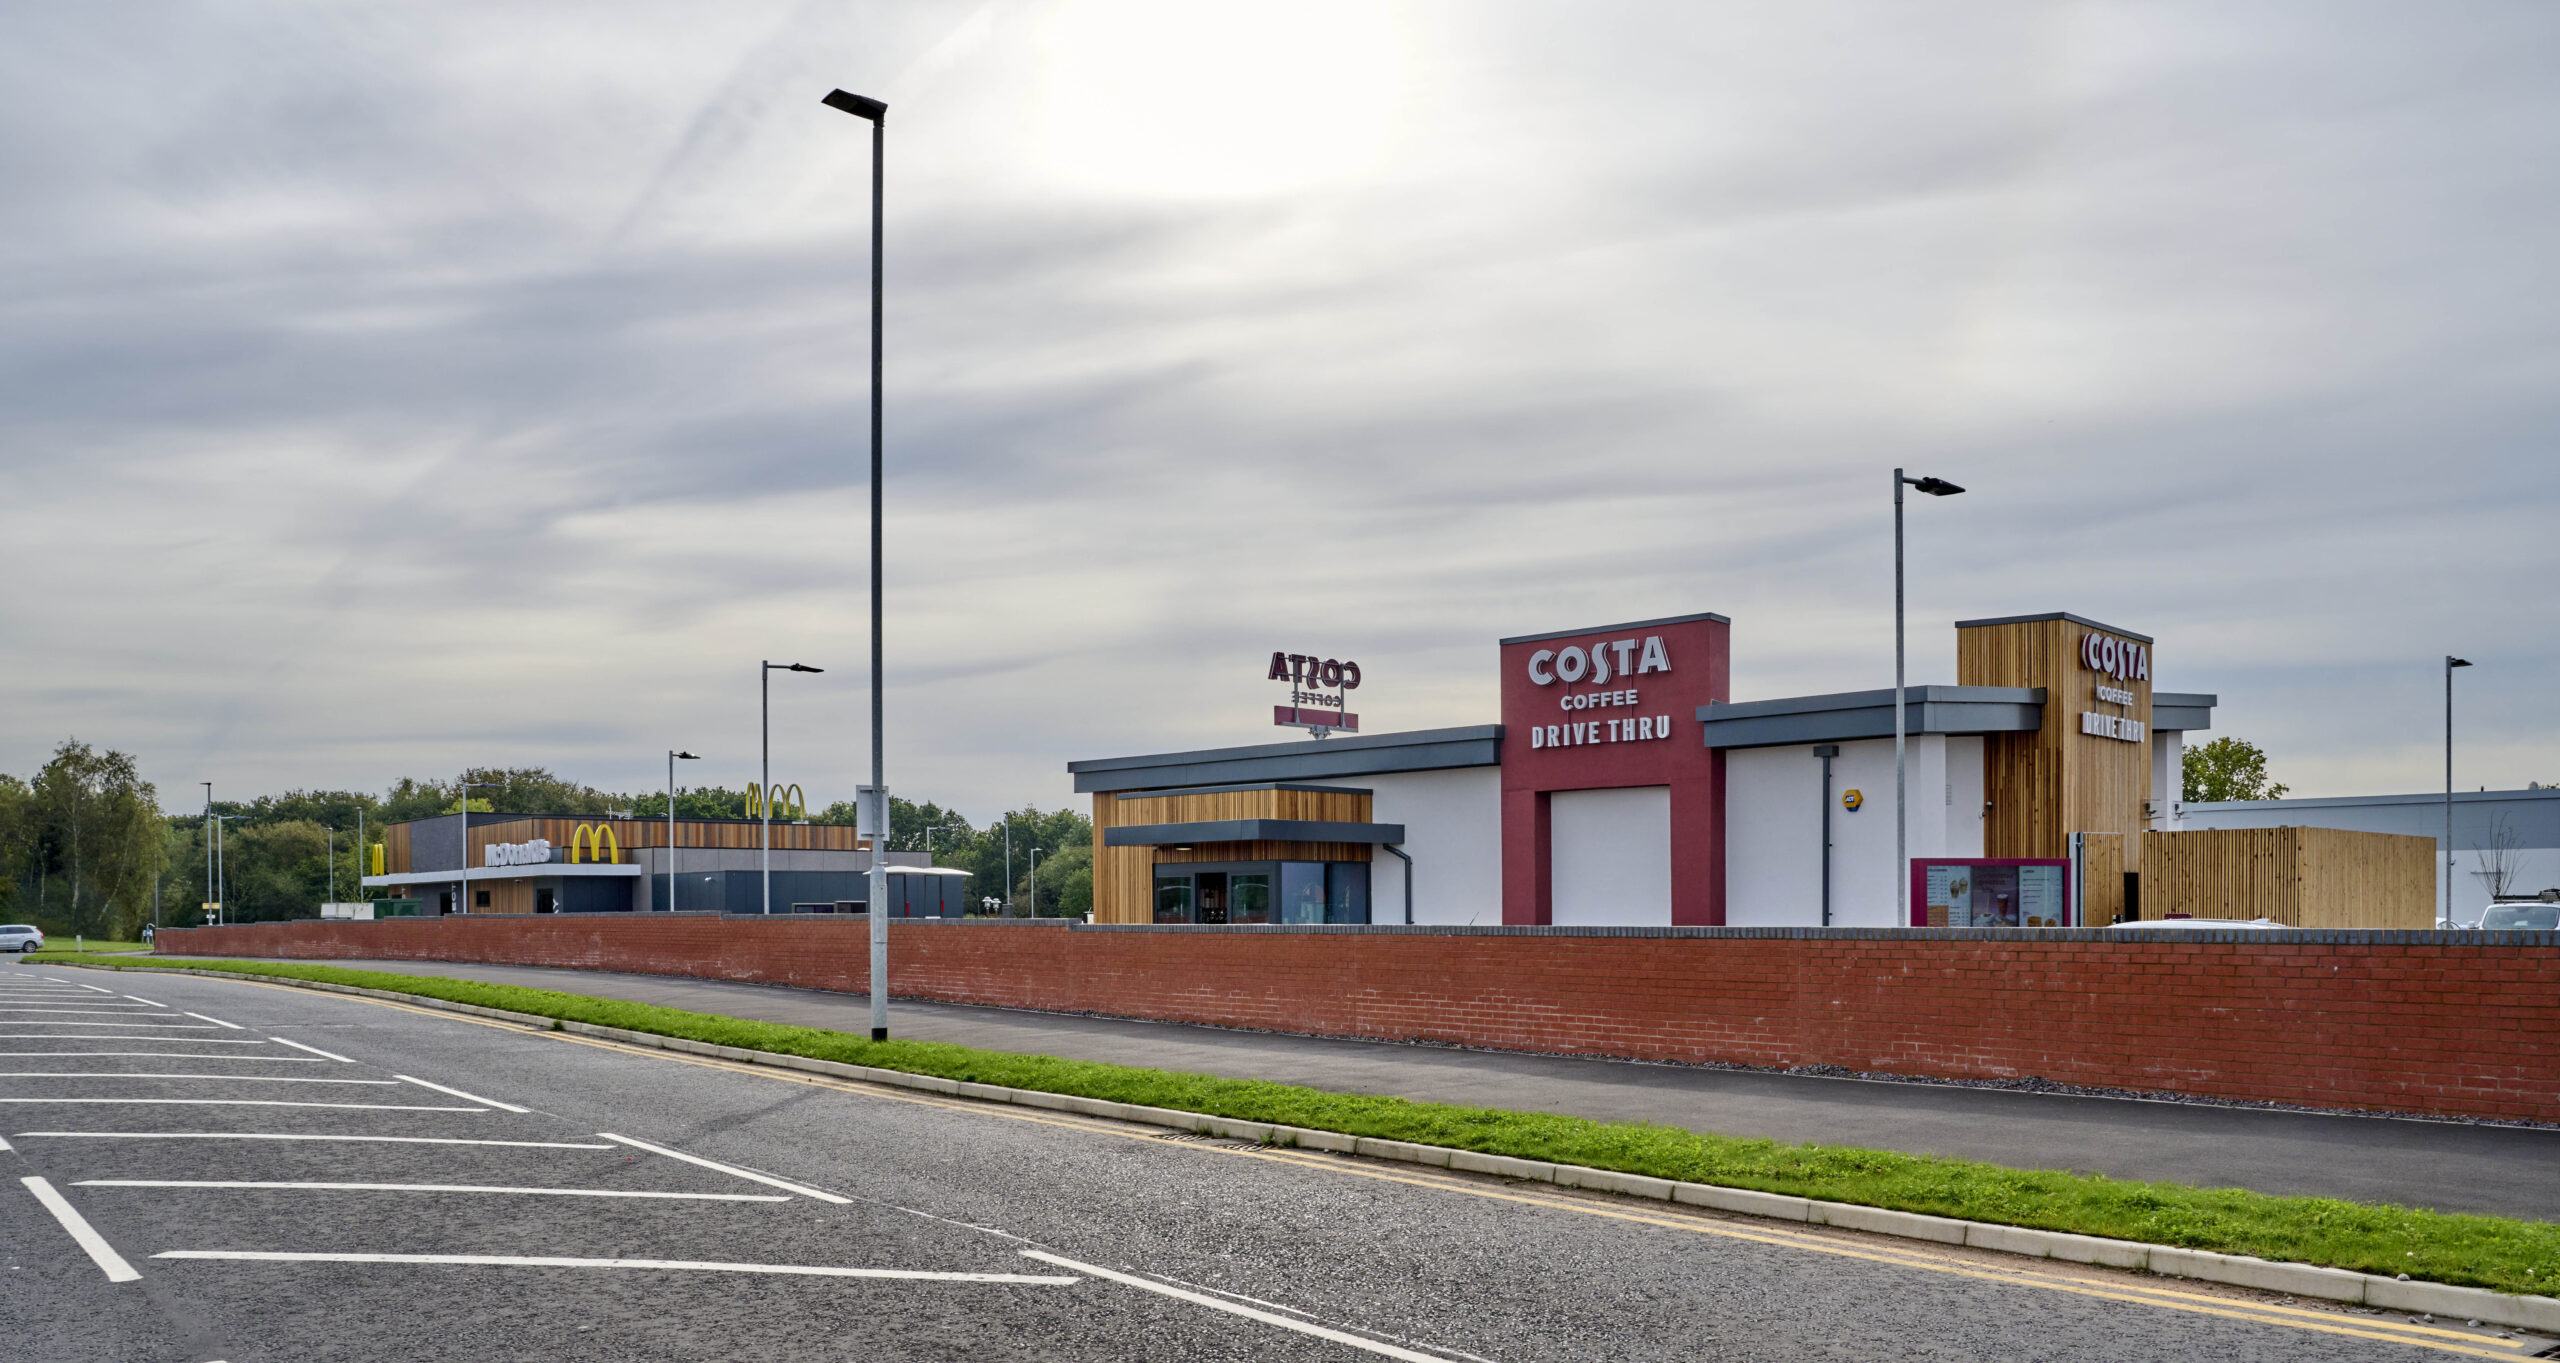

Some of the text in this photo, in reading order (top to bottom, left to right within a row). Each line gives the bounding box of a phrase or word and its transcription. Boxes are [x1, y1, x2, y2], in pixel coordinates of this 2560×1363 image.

[1528, 635, 1672, 686] COSTA
[2082, 632, 2149, 682] COSTA
[1560, 689, 1638, 711] COFFEE
[2097, 685, 2133, 706] COFFEE
[1531, 715, 1671, 749] DRIVE THRU
[2082, 711, 2145, 743] DRIVE THRU
